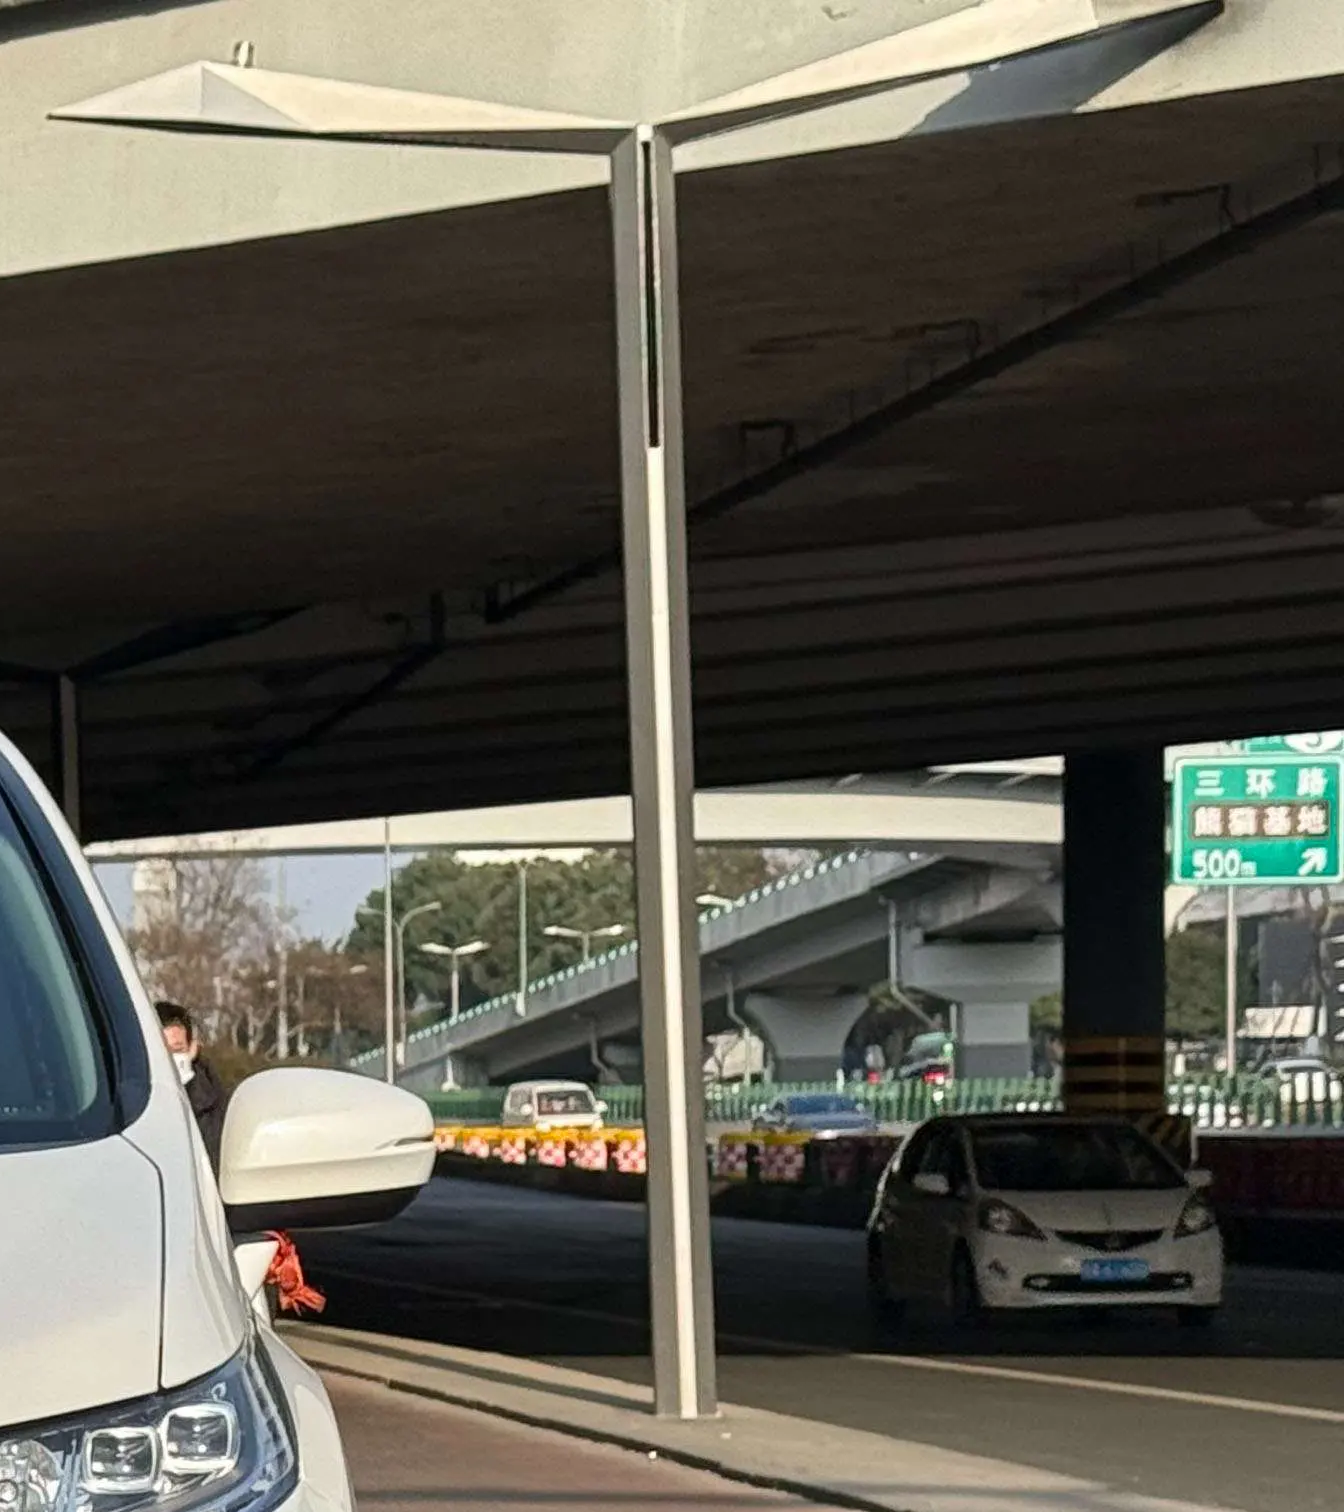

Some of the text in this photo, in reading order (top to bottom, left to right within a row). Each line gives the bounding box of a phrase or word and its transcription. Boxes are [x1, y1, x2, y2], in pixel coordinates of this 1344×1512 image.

[1193, 767, 1329, 798] 三环路
[1194, 805, 1328, 836] 熊猫基地
[1192, 849, 1257, 878] 500m
